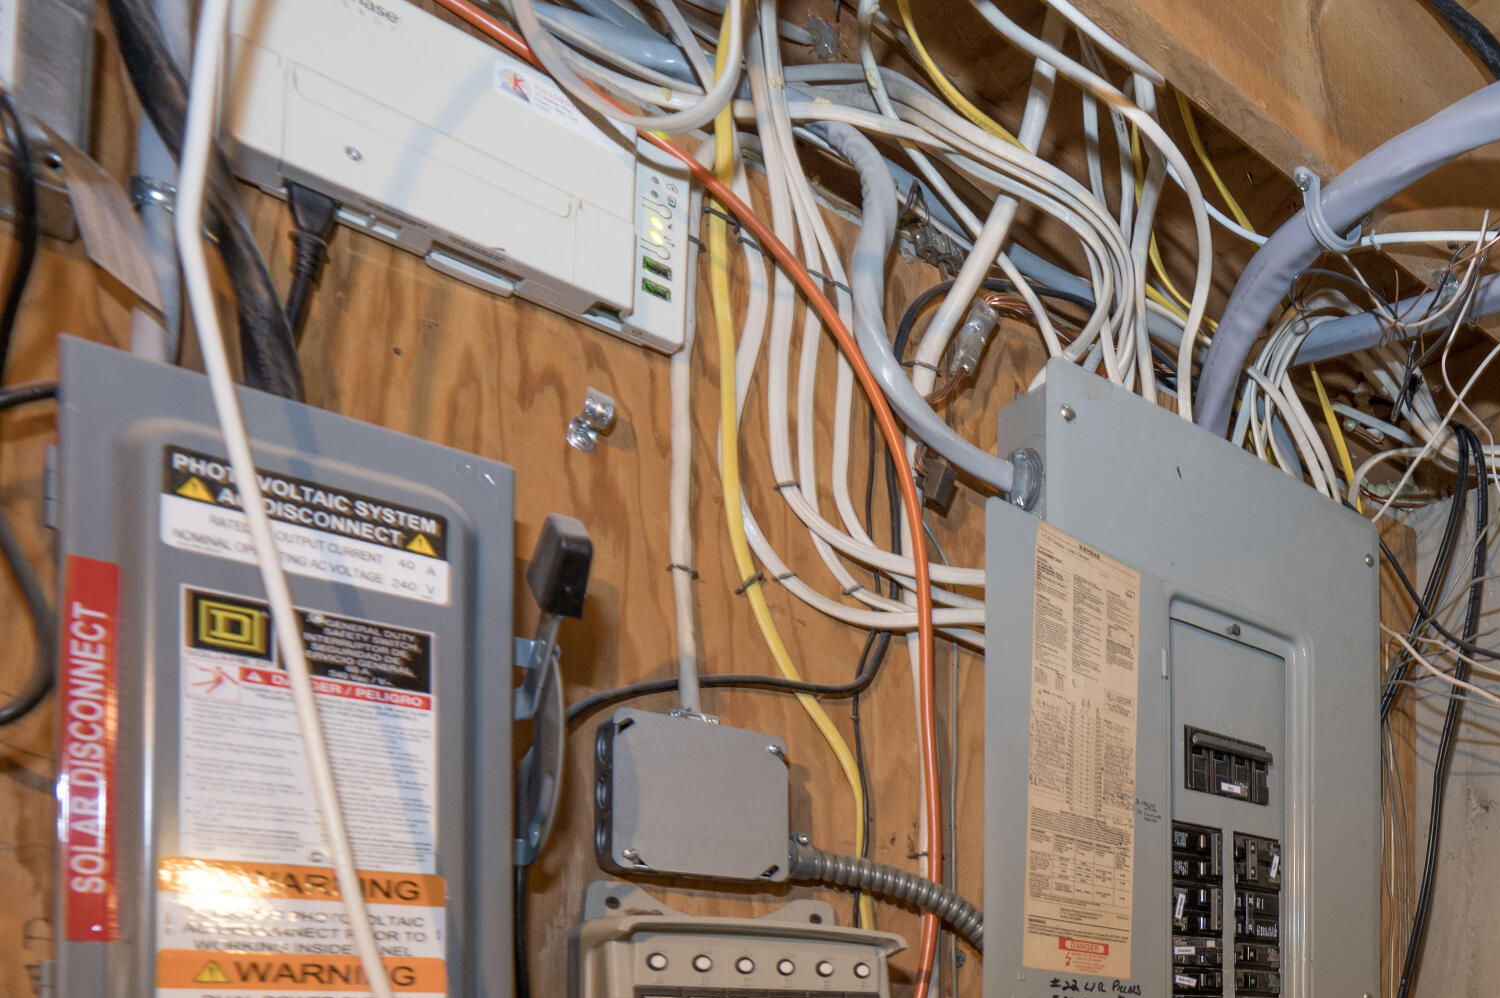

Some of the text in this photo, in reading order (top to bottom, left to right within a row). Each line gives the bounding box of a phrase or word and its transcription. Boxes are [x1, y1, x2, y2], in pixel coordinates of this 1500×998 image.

[172, 452, 437, 535] PHOTVOLTAIC SYSTEM
[264, 498, 402, 546] DISCONNECT
[308, 558, 326, 574] AC
[328, 562, 383, 585] VOLTAGE
[391, 577, 417, 592] 240
[328, 542, 384, 565] CURRENT
[397, 555, 416, 570] 40
[426, 565, 437, 577] A
[271, 674, 343, 696] DAGER
[355, 687, 423, 708] PELIGRO
[67, 600, 109, 894] SOLAR DISCONNECT
[253, 869, 419, 900] ARING
[1069, 941, 1100, 952] DANGER
[233, 959, 416, 986] WARNIG
